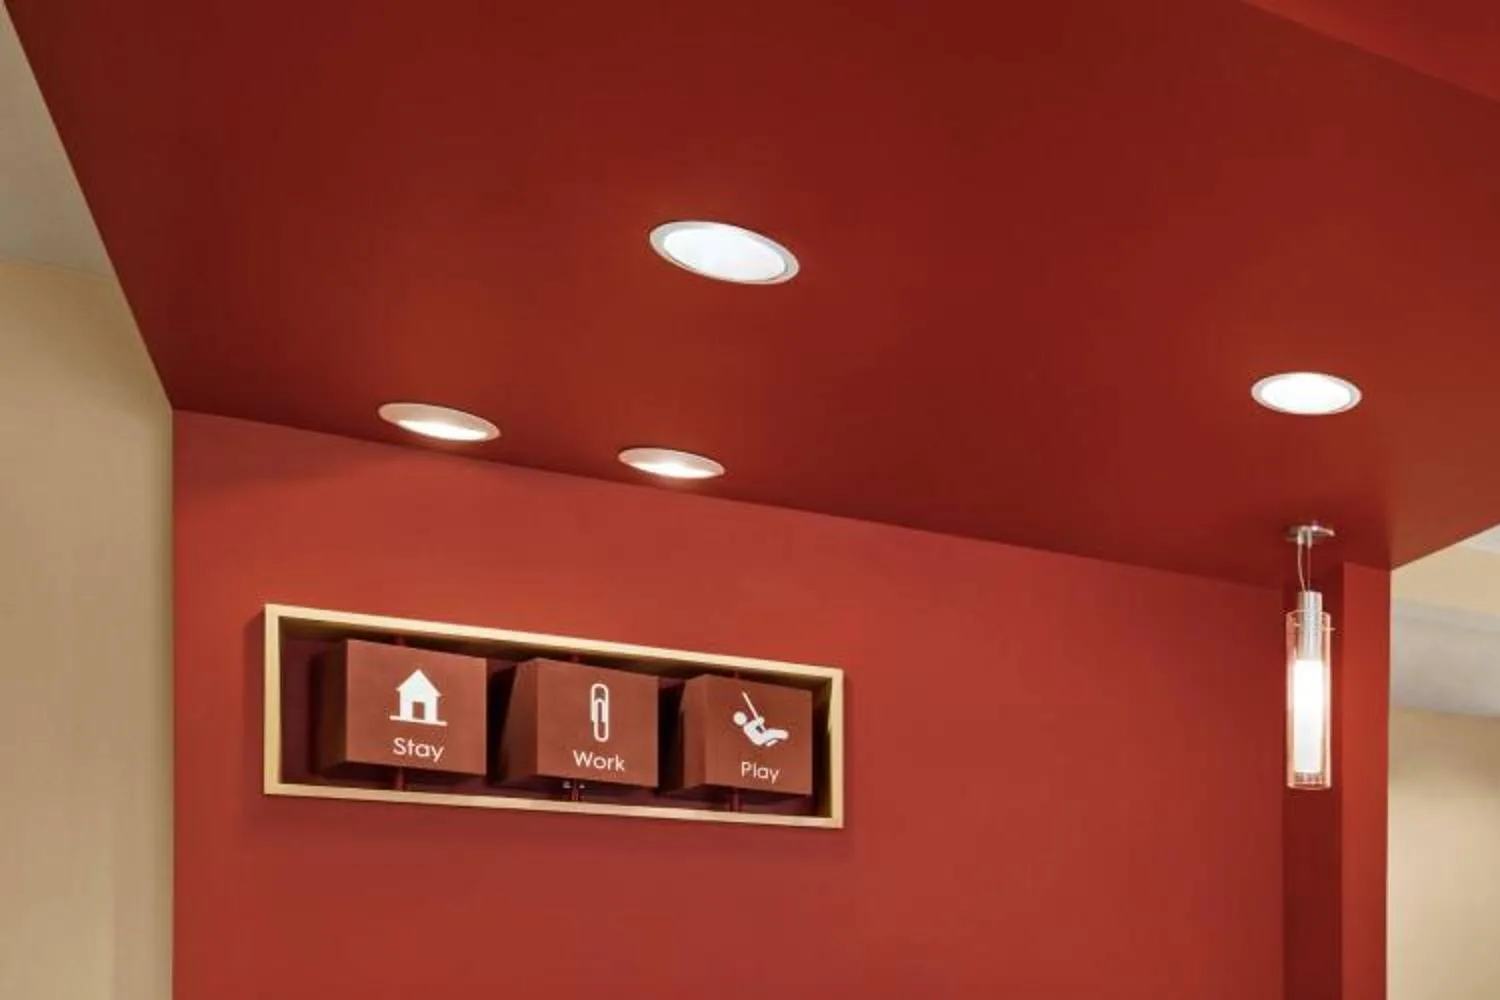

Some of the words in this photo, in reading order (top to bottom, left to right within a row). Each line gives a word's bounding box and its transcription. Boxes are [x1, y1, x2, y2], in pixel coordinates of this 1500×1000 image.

[392, 736, 445, 763] Stay
[572, 750, 625, 773] Work
[741, 761, 780, 783] Play
